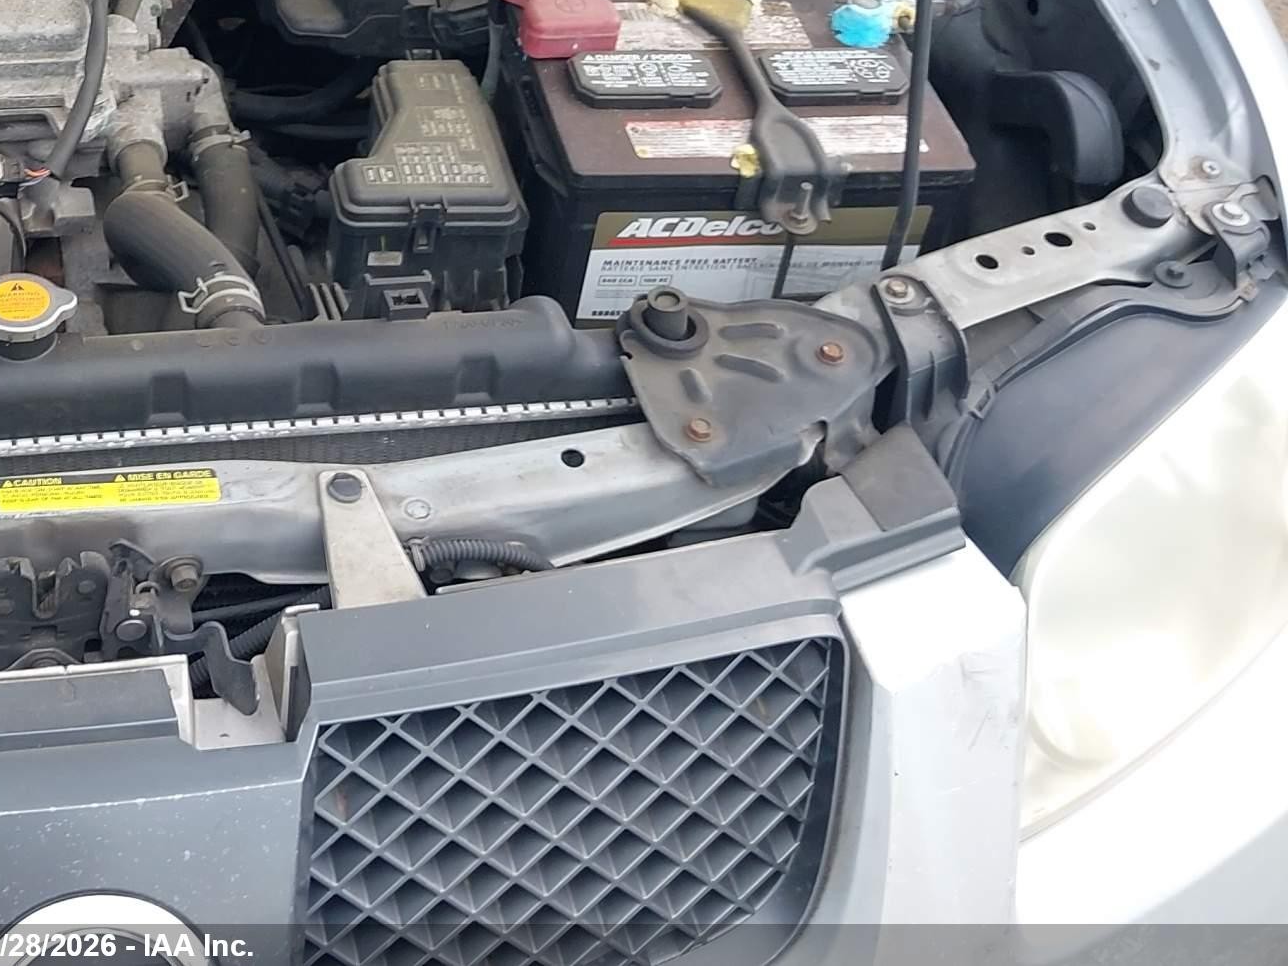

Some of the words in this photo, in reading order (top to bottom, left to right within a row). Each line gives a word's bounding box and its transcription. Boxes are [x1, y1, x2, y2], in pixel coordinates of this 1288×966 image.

[616, 216, 783, 238] ACDelco
[602, 259, 681, 267] MAINTENANCE
[713, 257, 758, 265] BATTERY
[172, 470, 212, 479] GARDE
[13, 477, 62, 488] CAUTION
